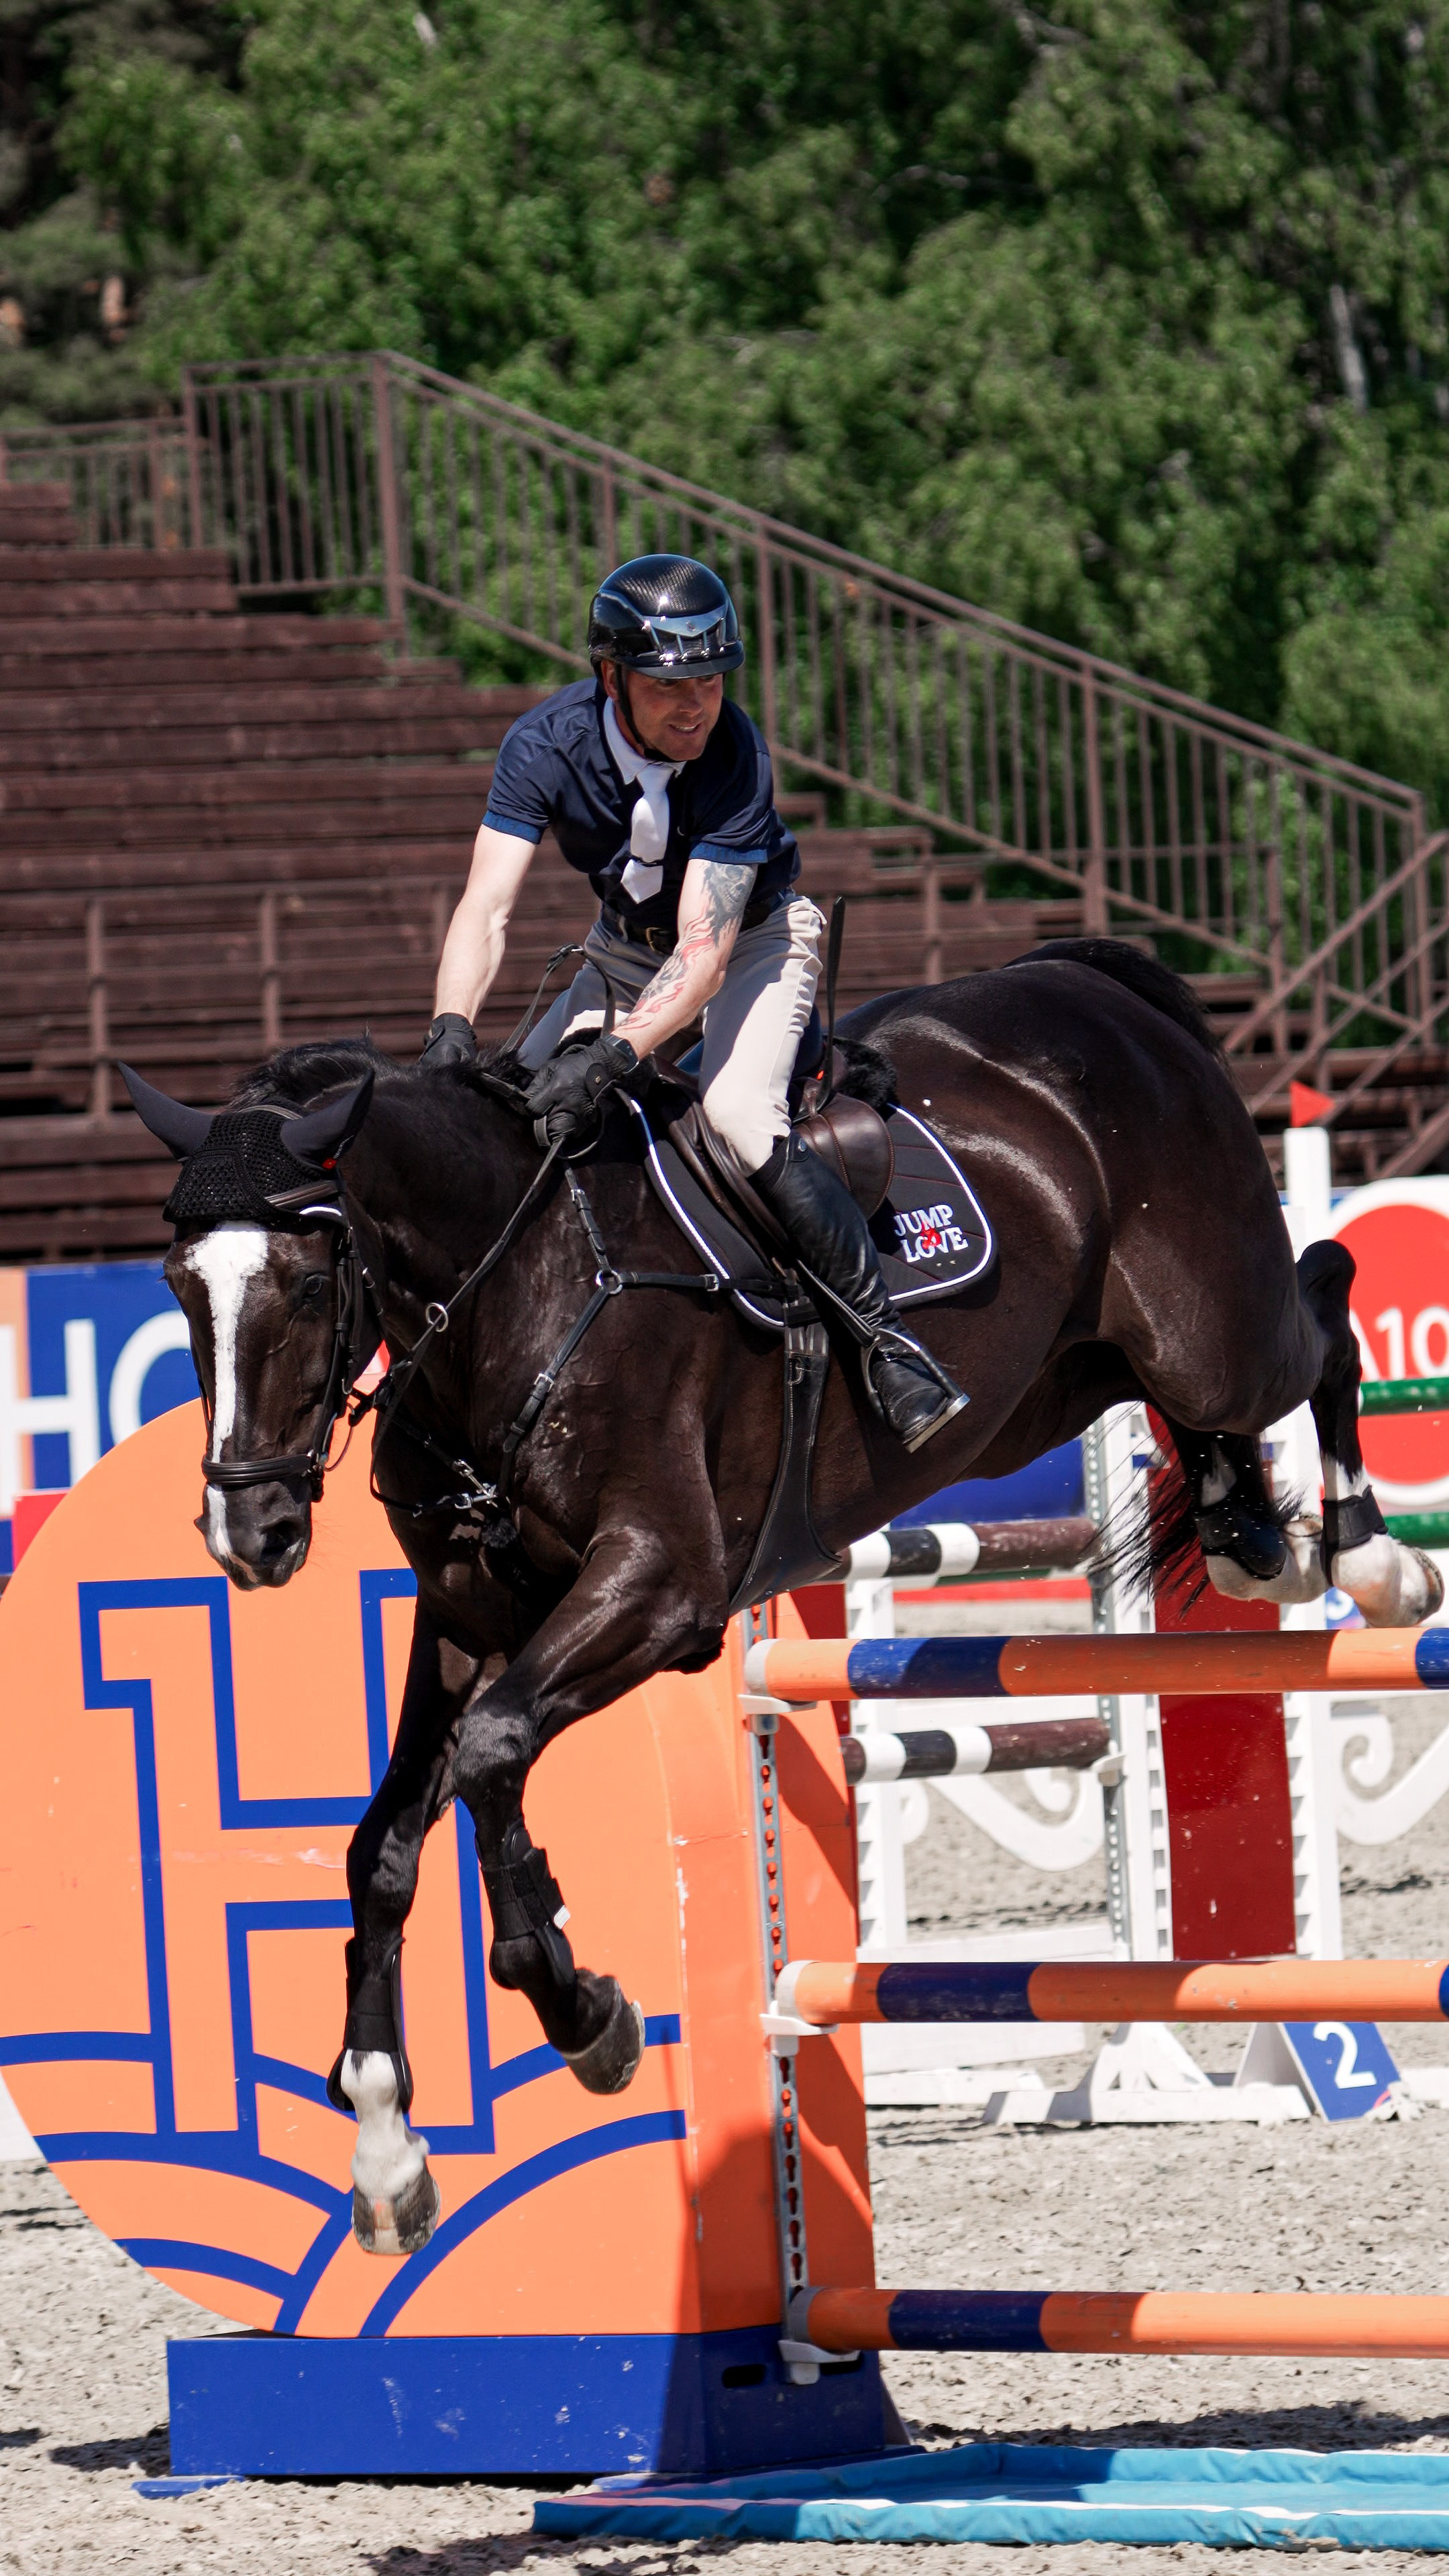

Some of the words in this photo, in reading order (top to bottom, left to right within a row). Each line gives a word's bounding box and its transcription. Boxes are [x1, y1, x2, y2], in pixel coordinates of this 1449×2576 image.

[893, 1204, 953, 1236] JUMP
[900, 1227, 969, 1263] LOVE
[1313, 2021, 1377, 2089] 2
